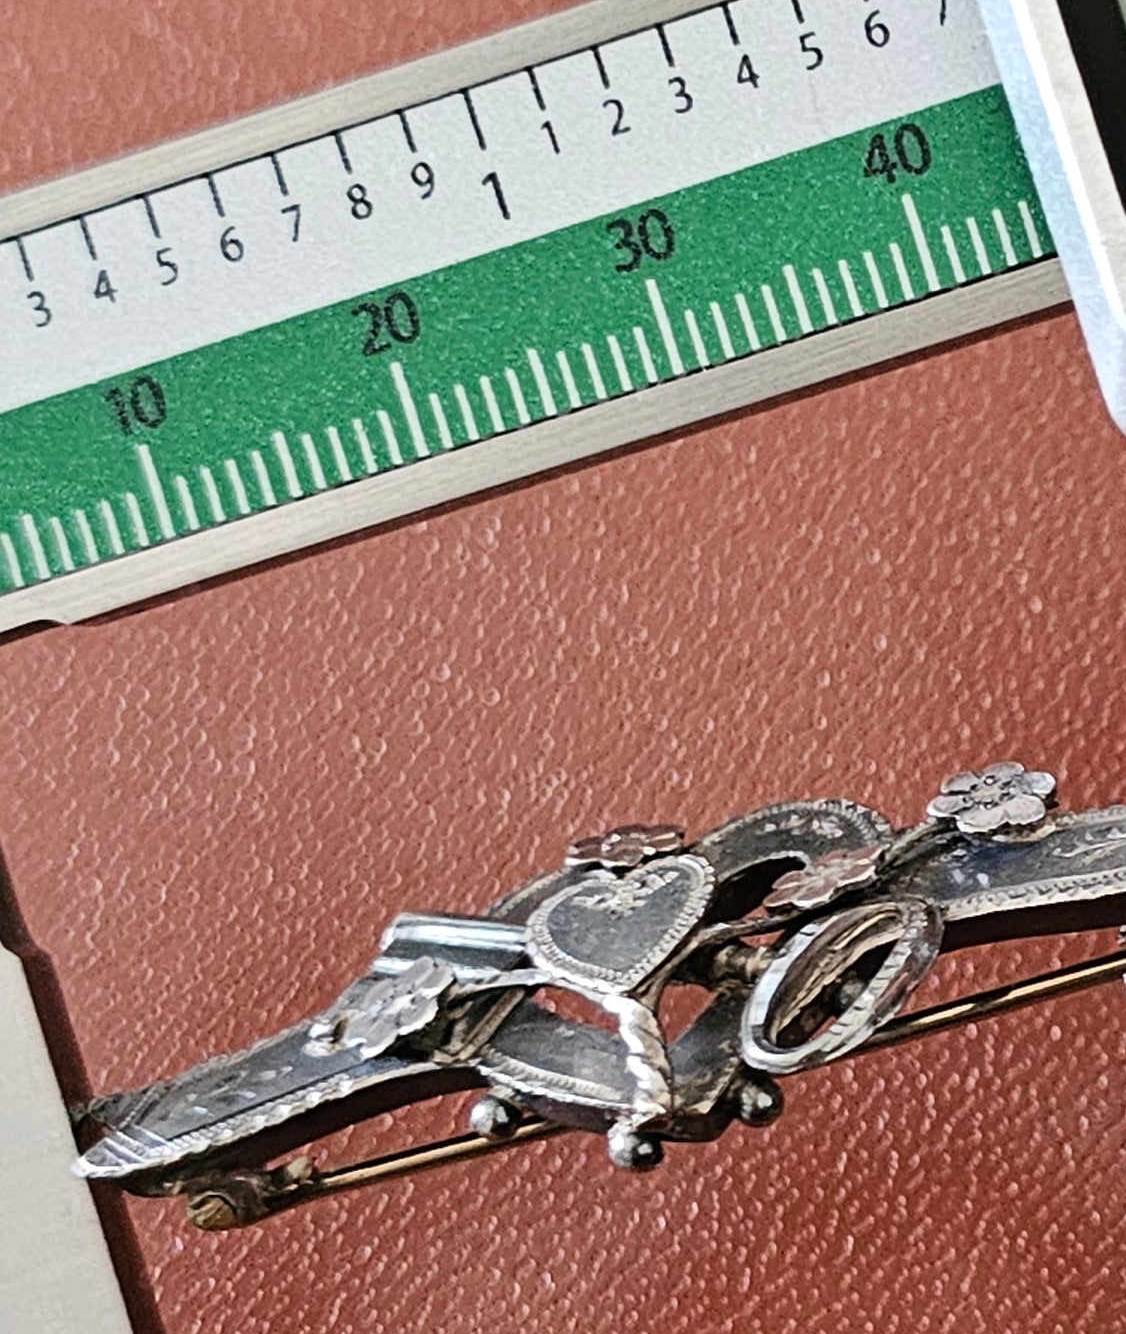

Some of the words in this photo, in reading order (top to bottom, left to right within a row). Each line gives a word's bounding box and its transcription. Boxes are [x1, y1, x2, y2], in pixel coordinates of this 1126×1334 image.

[26, 290, 52, 327] 3
[92, 270, 117, 303] 4
[155, 248, 179, 285] 5
[220, 226, 244, 262] 6
[280, 204, 303, 243] 7
[346, 183, 373, 220] 8
[410, 162, 436, 198] 9
[481, 171, 511, 220] 1
[540, 120, 560, 155] 1
[603, 99, 631, 135] 2
[668, 76, 694, 114] 3
[736, 54, 760, 89] 4
[800, 32, 824, 70] 5
[865, 11, 891, 48] 6
[107, 374, 168, 436] 10
[351, 291, 421, 357] 20
[605, 208, 675, 272] 30
[863, 123, 933, 184] 40
